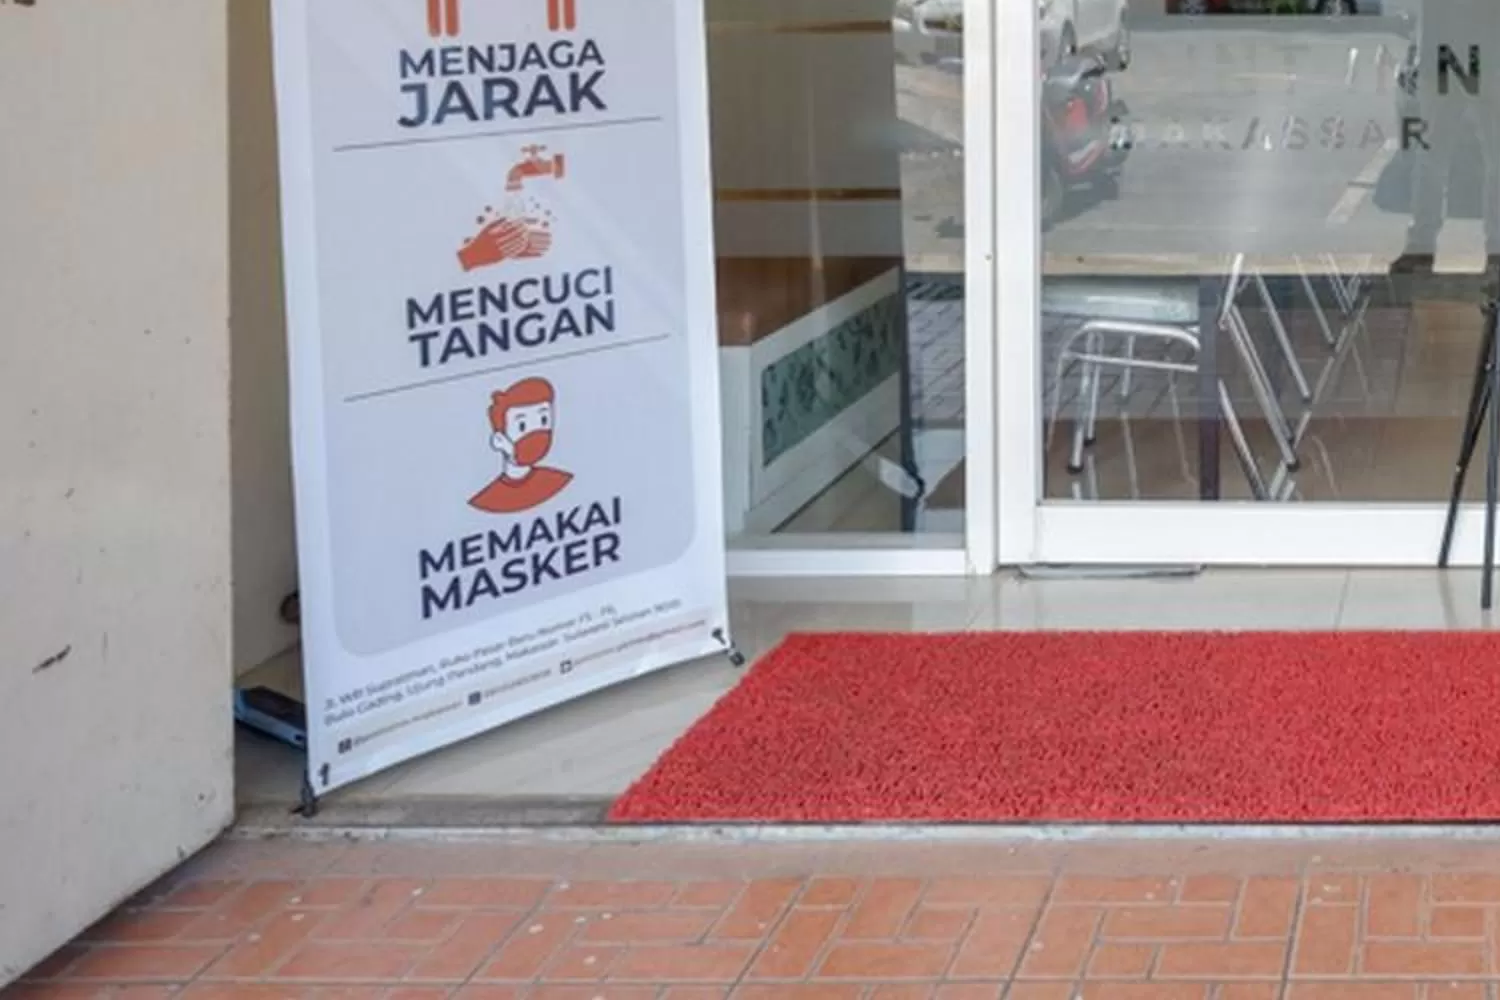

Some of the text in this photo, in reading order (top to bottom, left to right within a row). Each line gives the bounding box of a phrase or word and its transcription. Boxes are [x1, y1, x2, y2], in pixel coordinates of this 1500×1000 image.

[400, 38, 606, 79] MENJAGA
[397, 69, 608, 129] JARAK
[405, 265, 613, 331] MENCUCI
[408, 299, 616, 368] TANGAN
[419, 496, 622, 581] MEMAKAI
[420, 531, 621, 620] MASKER
